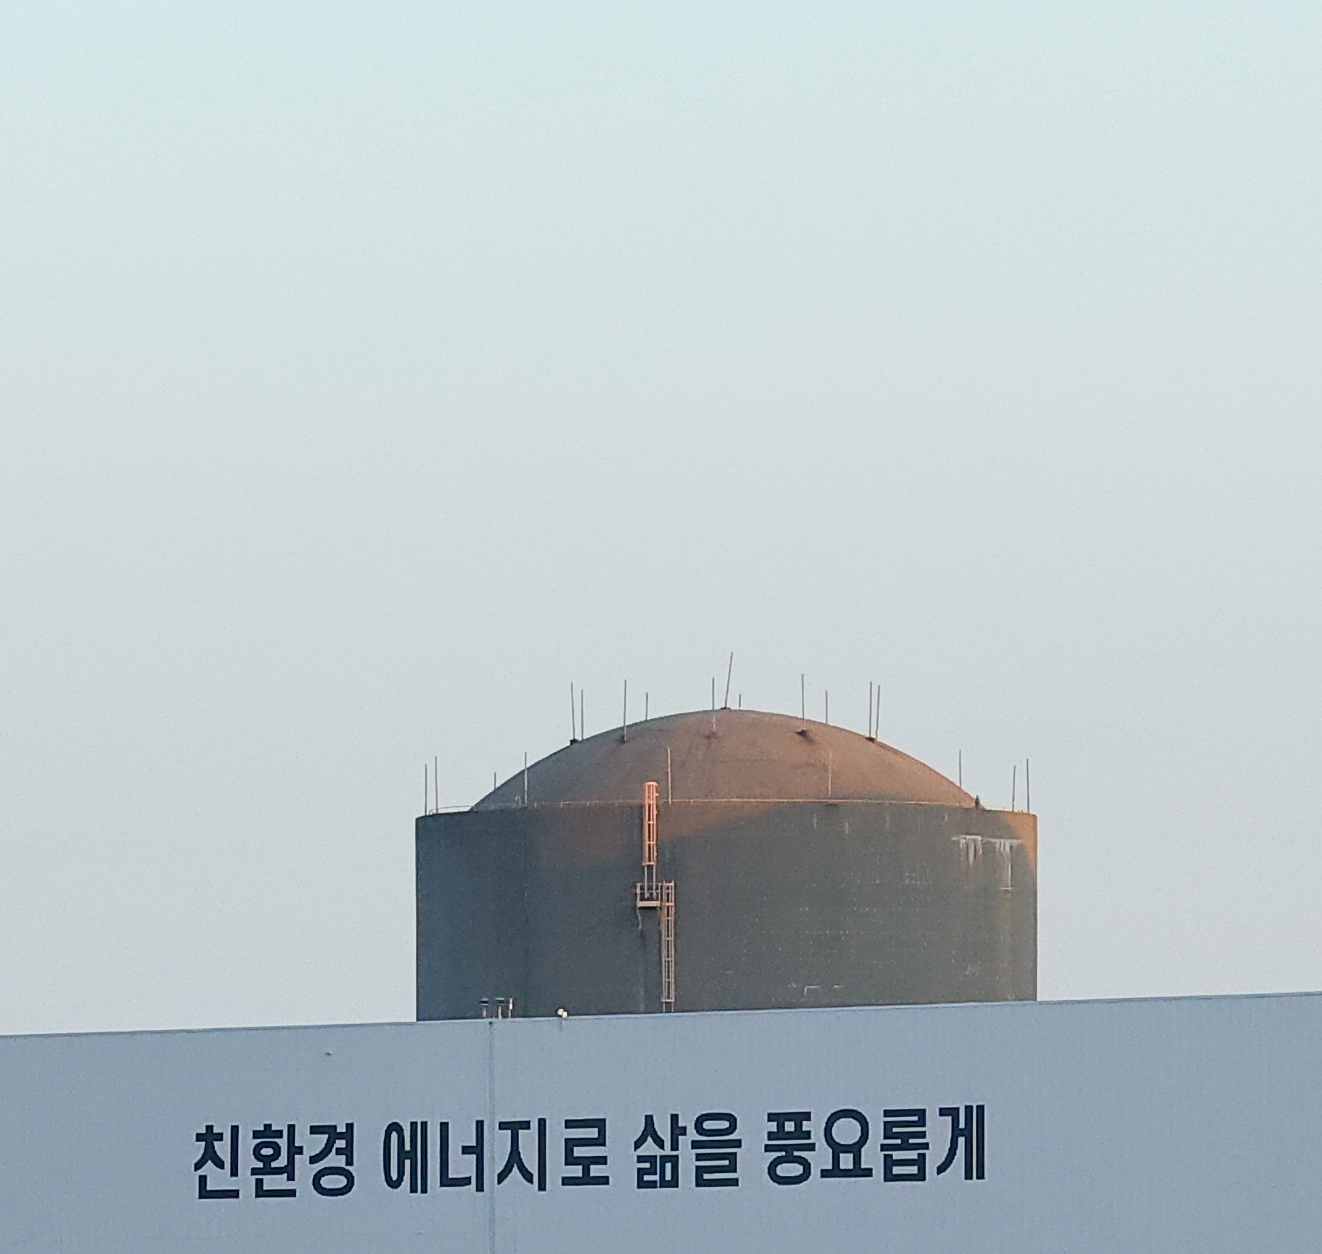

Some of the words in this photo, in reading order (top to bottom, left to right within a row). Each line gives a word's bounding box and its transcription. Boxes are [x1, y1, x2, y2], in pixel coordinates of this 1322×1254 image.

[193, 1122, 356, 1200] 친환경
[383, 1117, 610, 1194] 에너지로
[633, 1112, 743, 1189] 삶을
[764, 1104, 986, 1186] 풍요롭게
